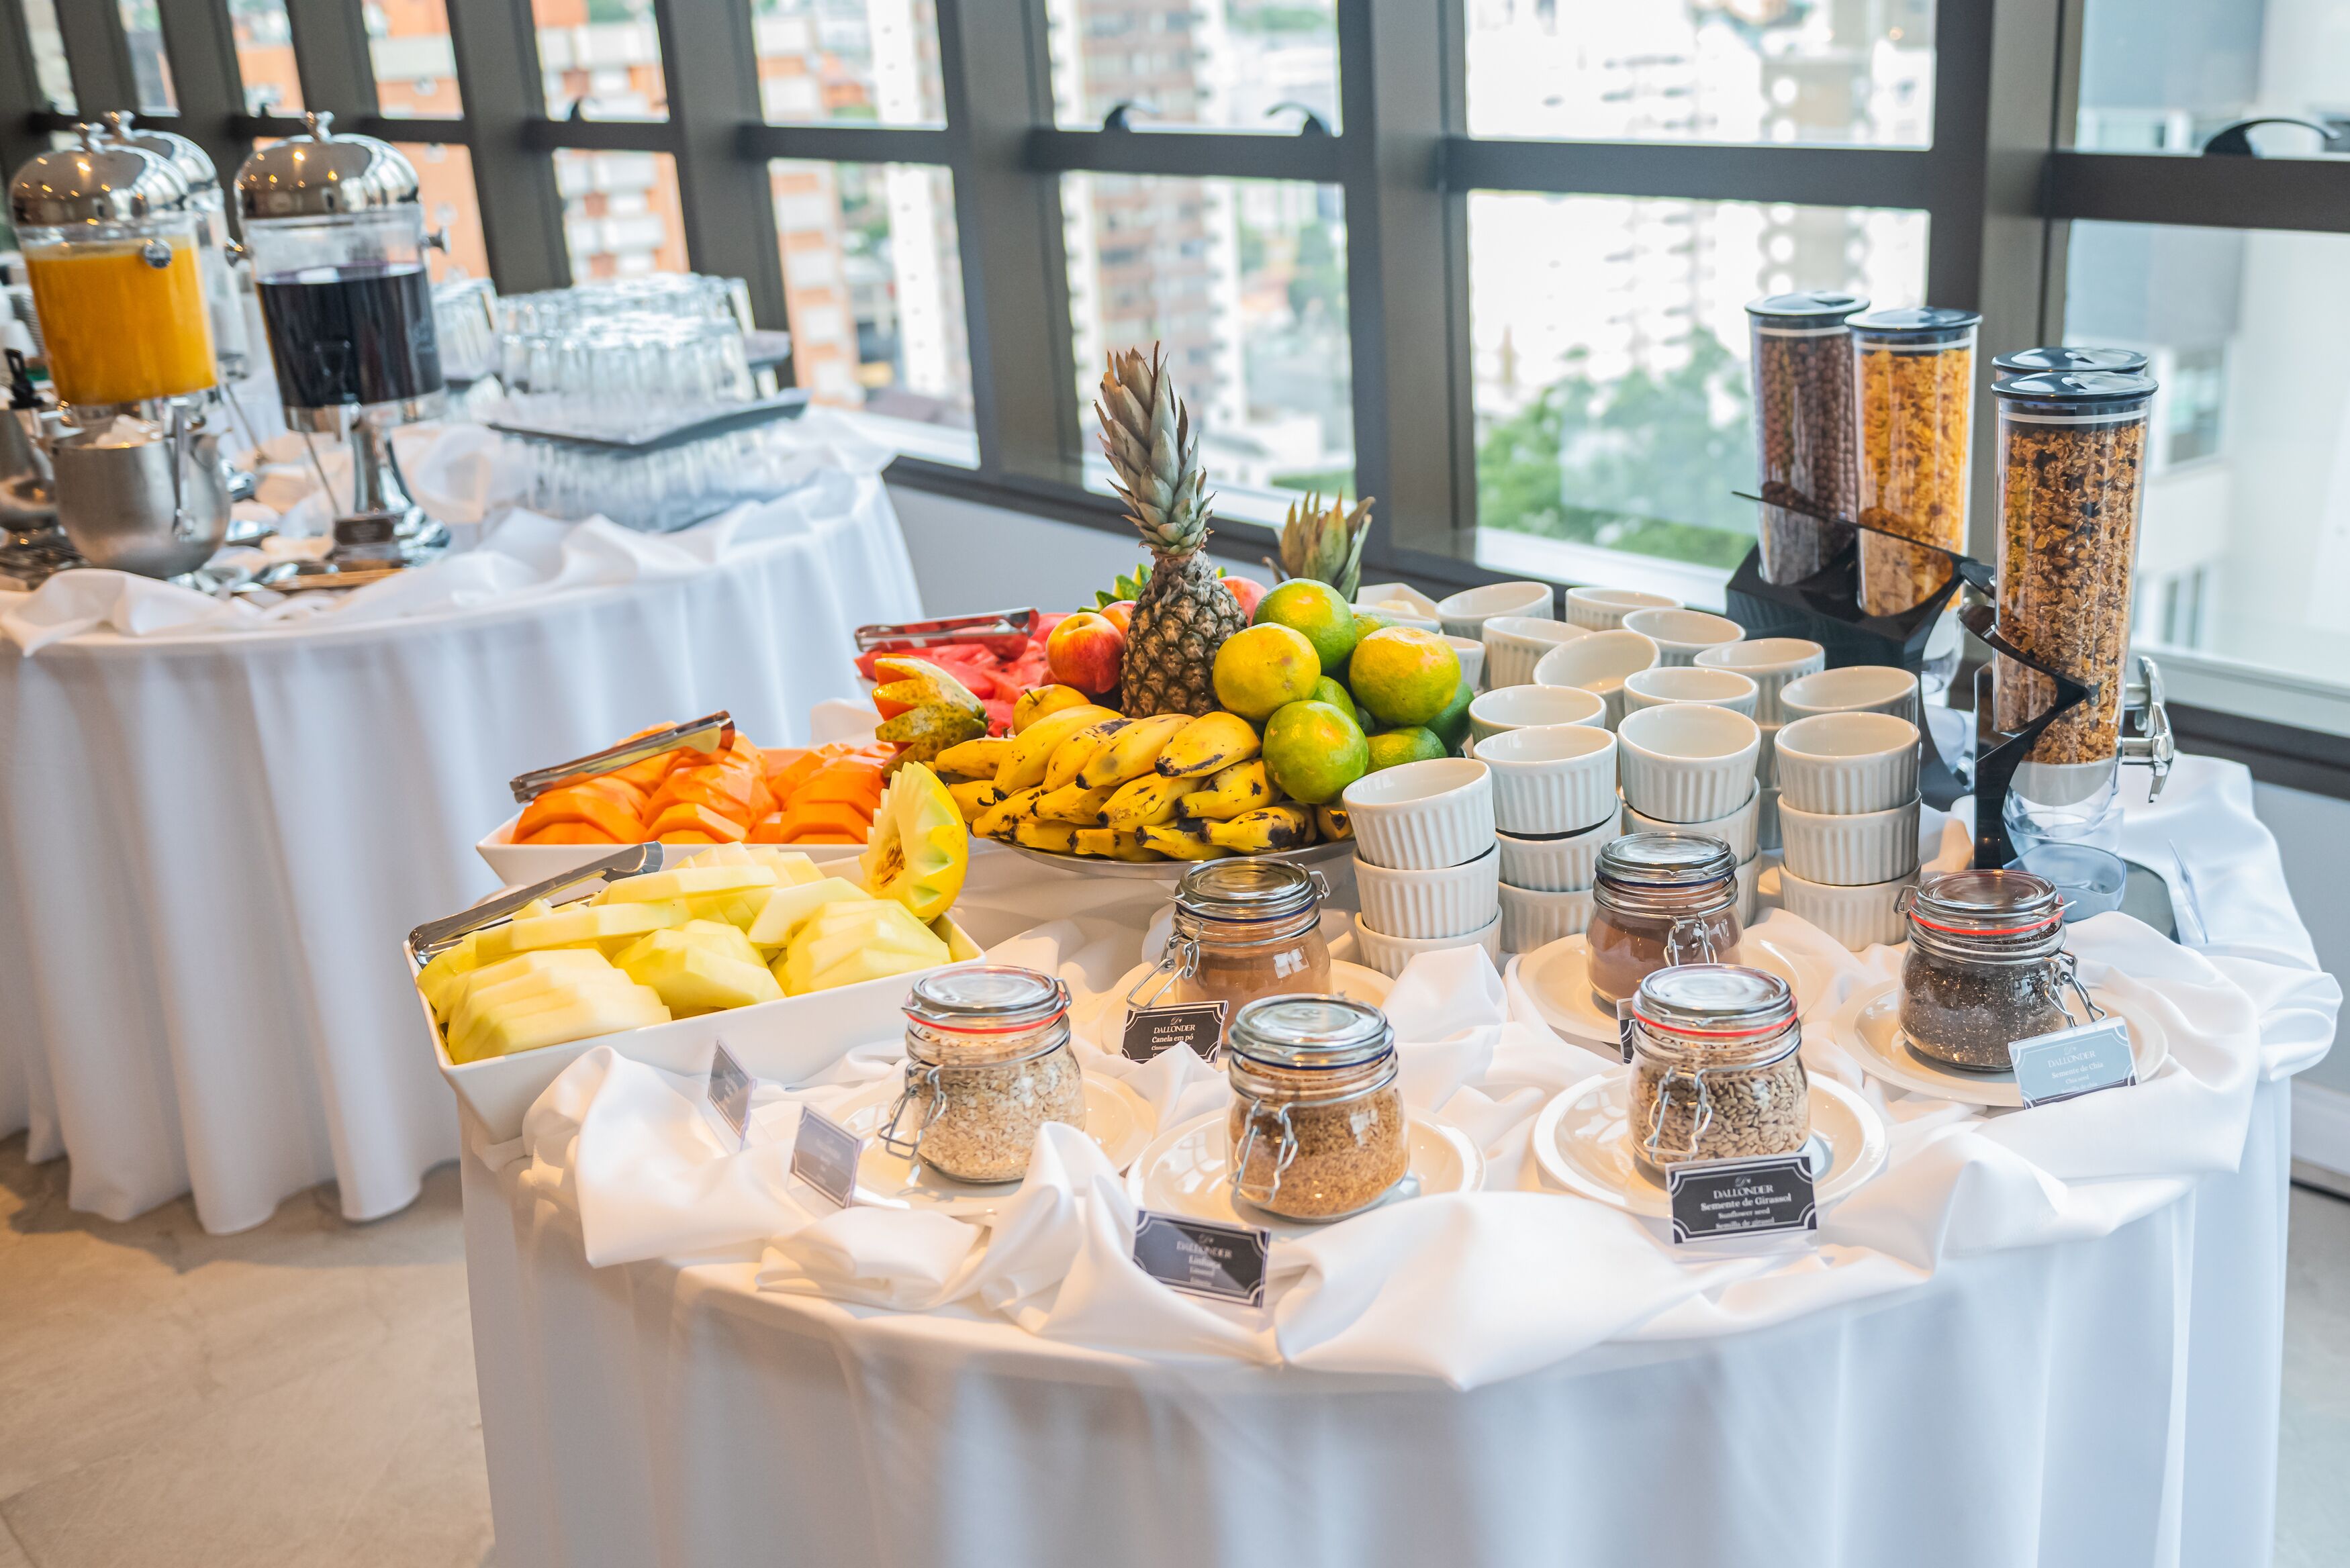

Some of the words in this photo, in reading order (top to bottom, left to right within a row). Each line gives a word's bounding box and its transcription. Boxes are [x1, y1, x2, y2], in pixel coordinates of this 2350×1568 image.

[1152, 1034, 1173, 1043] Canela
[1185, 1034, 1194, 1042] pó
[2051, 1068, 2079, 1079] Semente
[2089, 1062, 2104, 1070] Chia
[1701, 1200, 1741, 1212] Semente
[1741, 1197, 1753, 1207] de
[1755, 1193, 1791, 1205] Girassol
